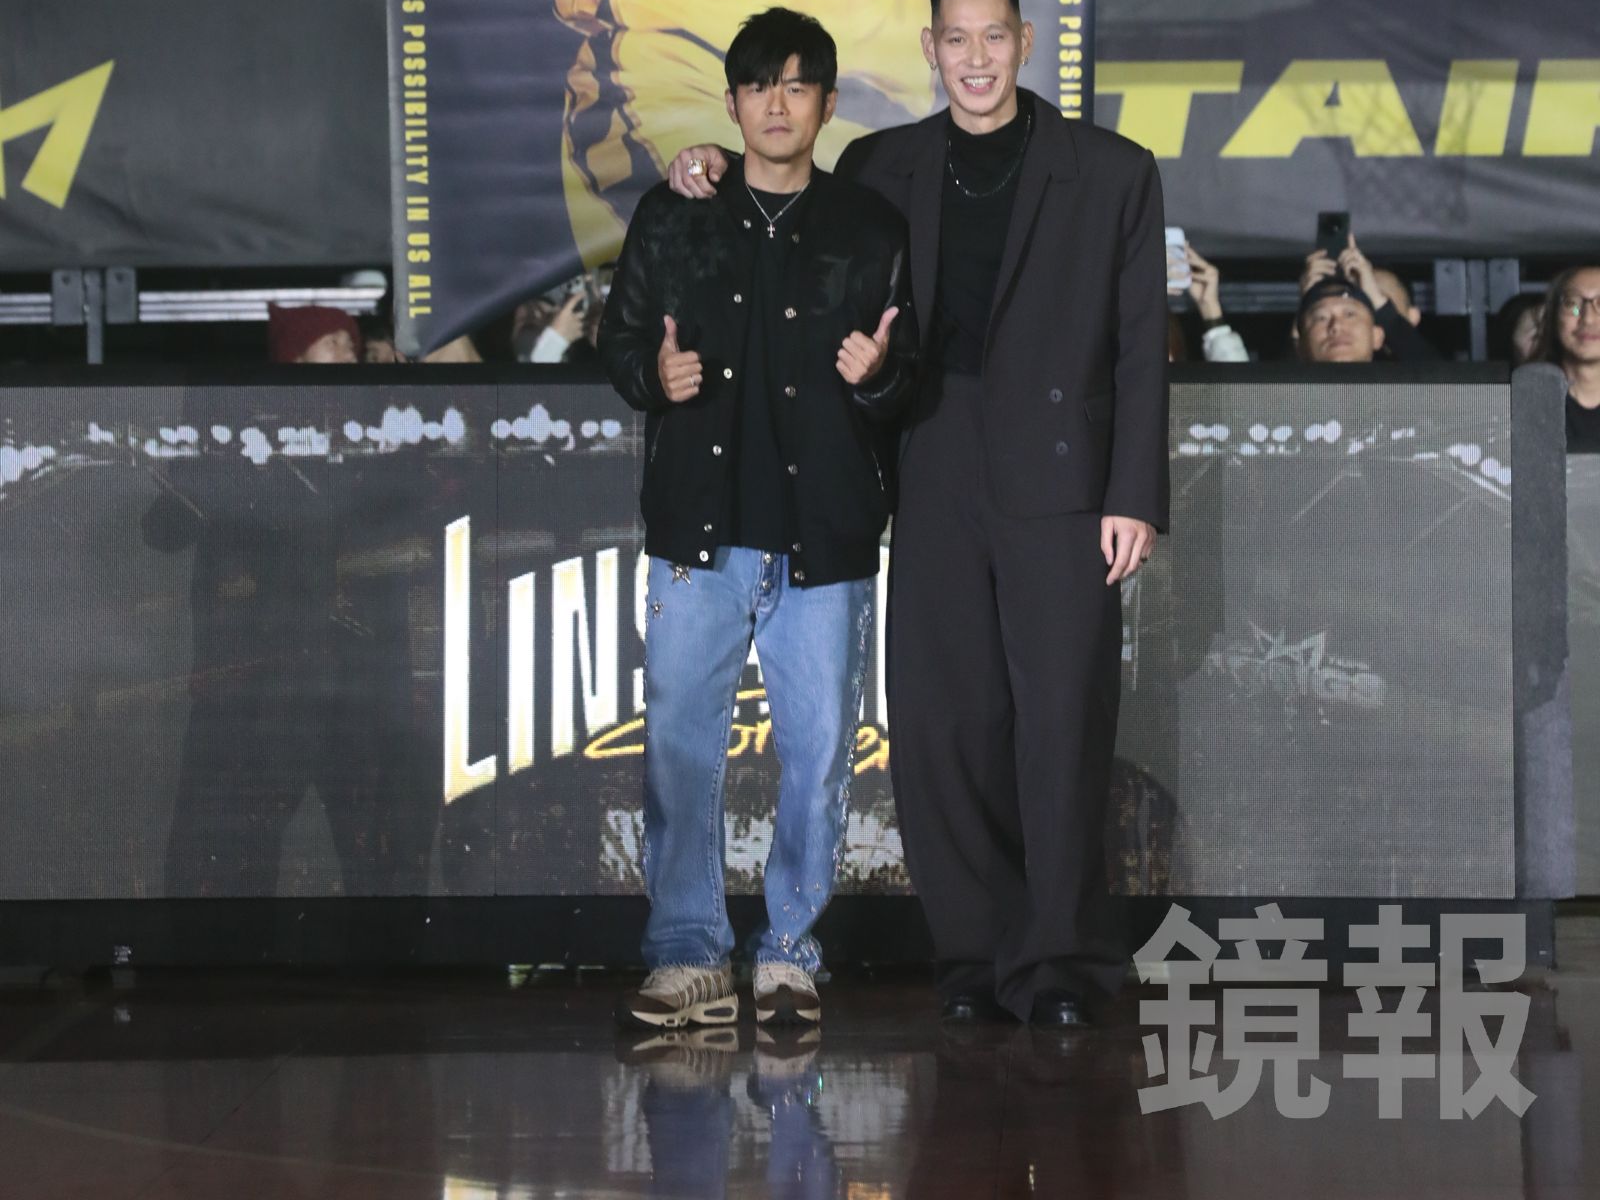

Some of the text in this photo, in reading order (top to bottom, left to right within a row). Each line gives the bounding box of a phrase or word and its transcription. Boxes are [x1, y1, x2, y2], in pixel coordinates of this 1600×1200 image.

[403, 25, 428, 184] POSSIBILITY
[407, 196, 429, 221] IN
[407, 233, 431, 262] US
[408, 274, 432, 317] ALL
